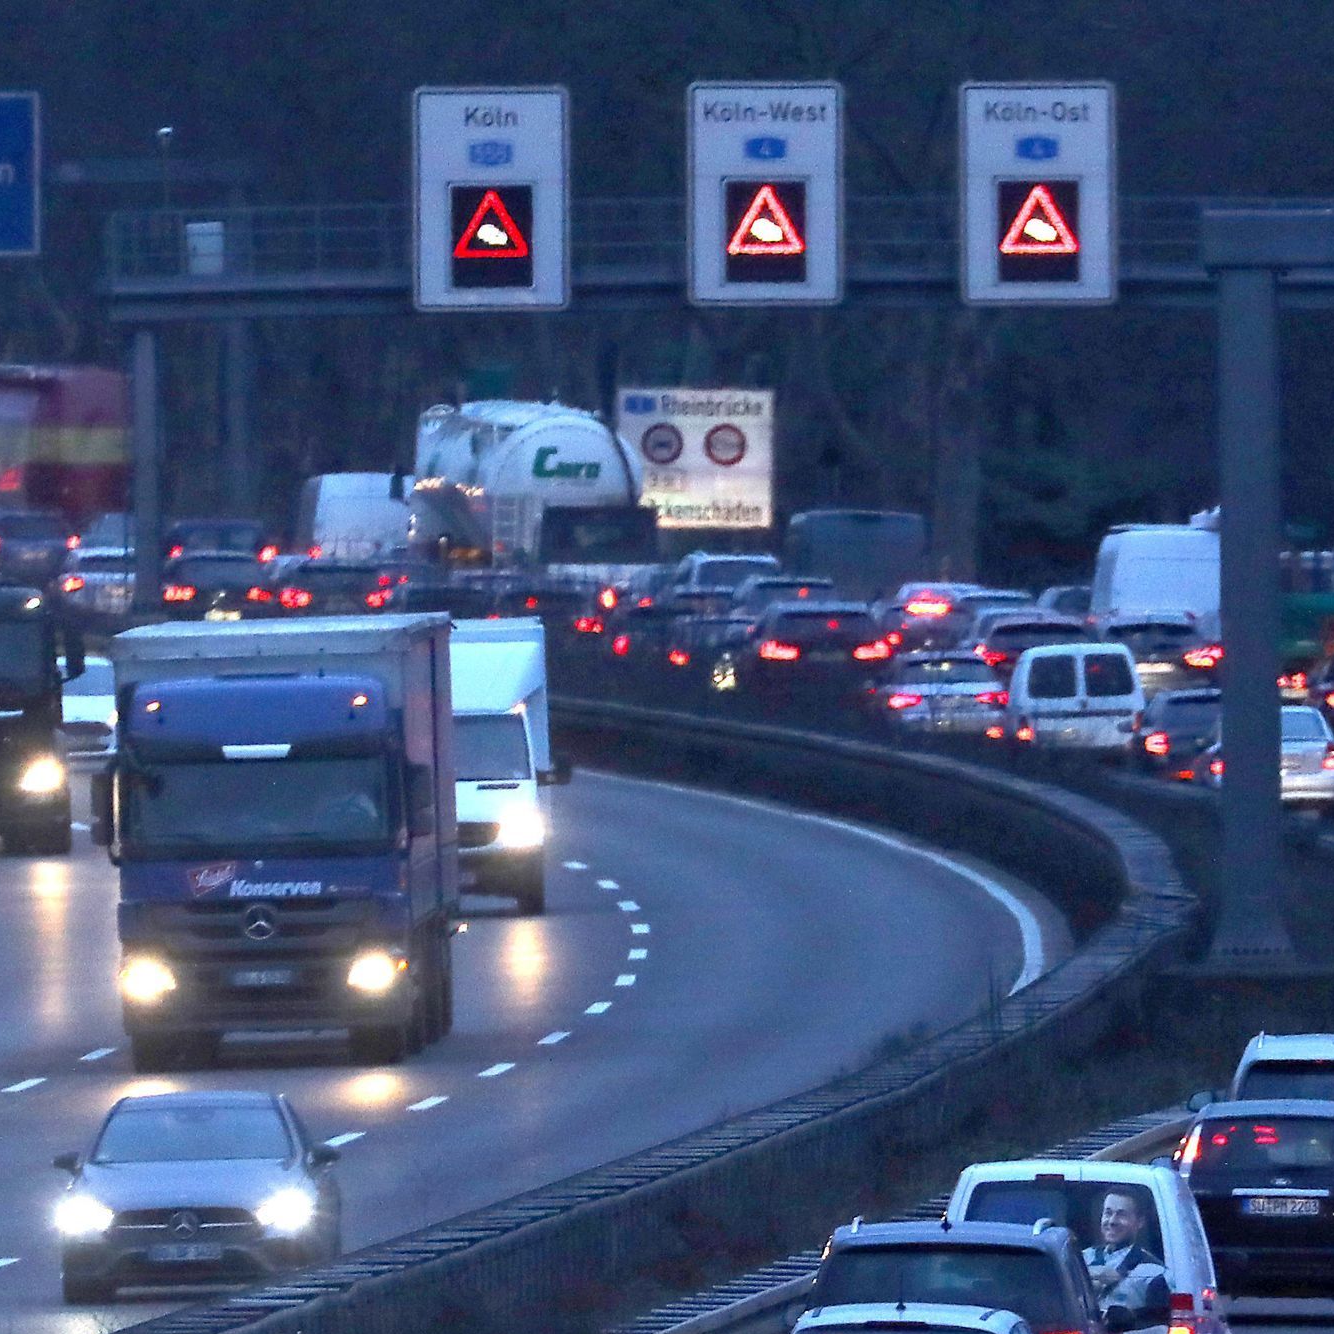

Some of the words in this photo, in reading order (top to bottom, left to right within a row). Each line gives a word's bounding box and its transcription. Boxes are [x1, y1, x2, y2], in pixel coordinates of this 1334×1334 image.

[465, 106, 517, 128] Köln
[703, 101, 827, 122] Köln-West
[984, 101, 1090, 122] Köln-Ost
[229, 878, 322, 897] Konserven
